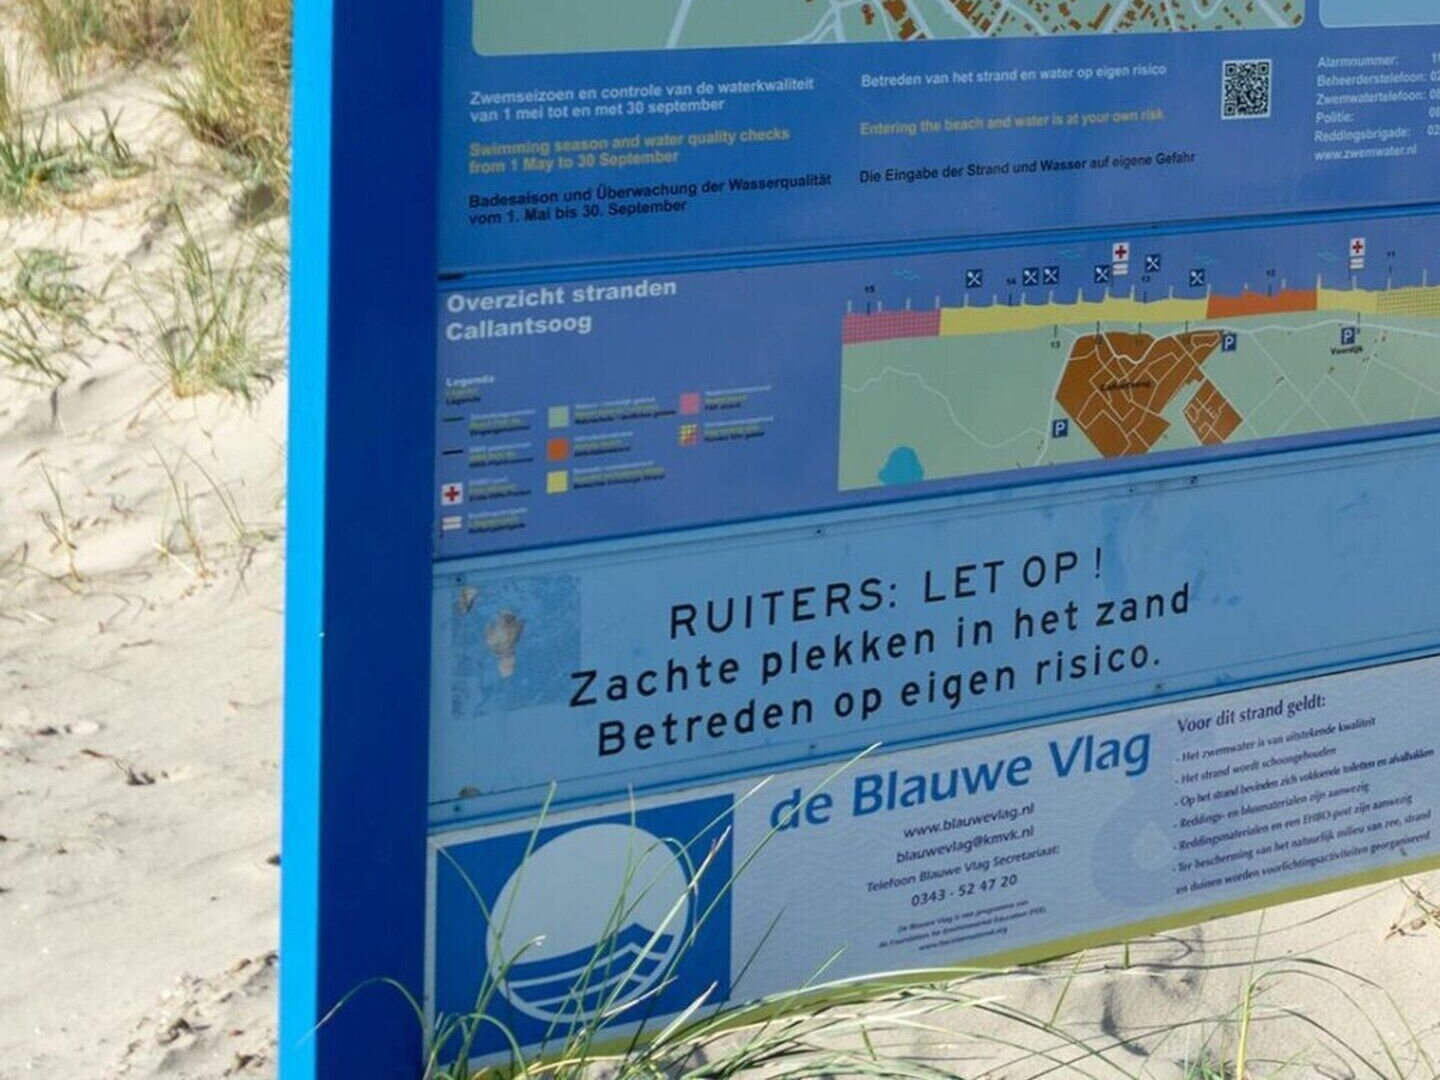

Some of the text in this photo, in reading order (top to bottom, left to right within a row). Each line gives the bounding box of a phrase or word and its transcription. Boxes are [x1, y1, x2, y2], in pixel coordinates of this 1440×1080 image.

[1317, 55, 1398, 68] Alarmnummer:
[862, 64, 1166, 87] Betreden van het strand en water op eigen risico
[1317, 71, 1425, 87] Beheerderstelefoon:
[470, 79, 814, 104] Zwemseizoen en controle van de waterkwaliteit
[1316, 90, 1426, 106] Zwemwatertelefoon:
[471, 100, 724, 122] van 1 mei tot en met 30 september
[860, 109, 1163, 135] Entering the beach and water is at your own risk
[1316, 109, 1354, 124] Politie:
[469, 129, 789, 156] Swimming season and water quality checks
[1314, 127, 1411, 144] Reddingsbrigade:
[469, 152, 678, 173] from 1 May to 30 September
[1314, 145, 1417, 161] www.zwemwater.nl
[860, 153, 1196, 183] Die Eingabe der Strand und Wasser auf eigene Gefahr
[469, 174, 832, 207] Badesaison und Überwachung der Wasserqualität
[469, 201, 687, 225] vom 1. Mai bis 30. September
[447, 279, 677, 313] Overzicht stranden
[446, 313, 592, 341] Callantsoog
[670, 580, 898, 639] RUITERS:
[924, 561, 1003, 604] LET
[569, 581, 1191, 708] Zachte plekken in het zand
[599, 639, 1161, 757] Betreden op eigen risico.
[1178, 695, 1325, 732] Voor dit strand geldt:
[770, 732, 1152, 832] de Blauwe Vlag
[903, 803, 1035, 839] www.blauwevlag.nl
[896, 826, 1035, 864] blauwevlag@kmvk.nl
[867, 845, 1060, 893] Telefoon Blauwe Vlag Secretariaat:
[911, 889, 946, 907] 0343
[958, 883, 976, 898] 52
[980, 879, 997, 893] 47
[1001, 874, 1018, 888] 20
